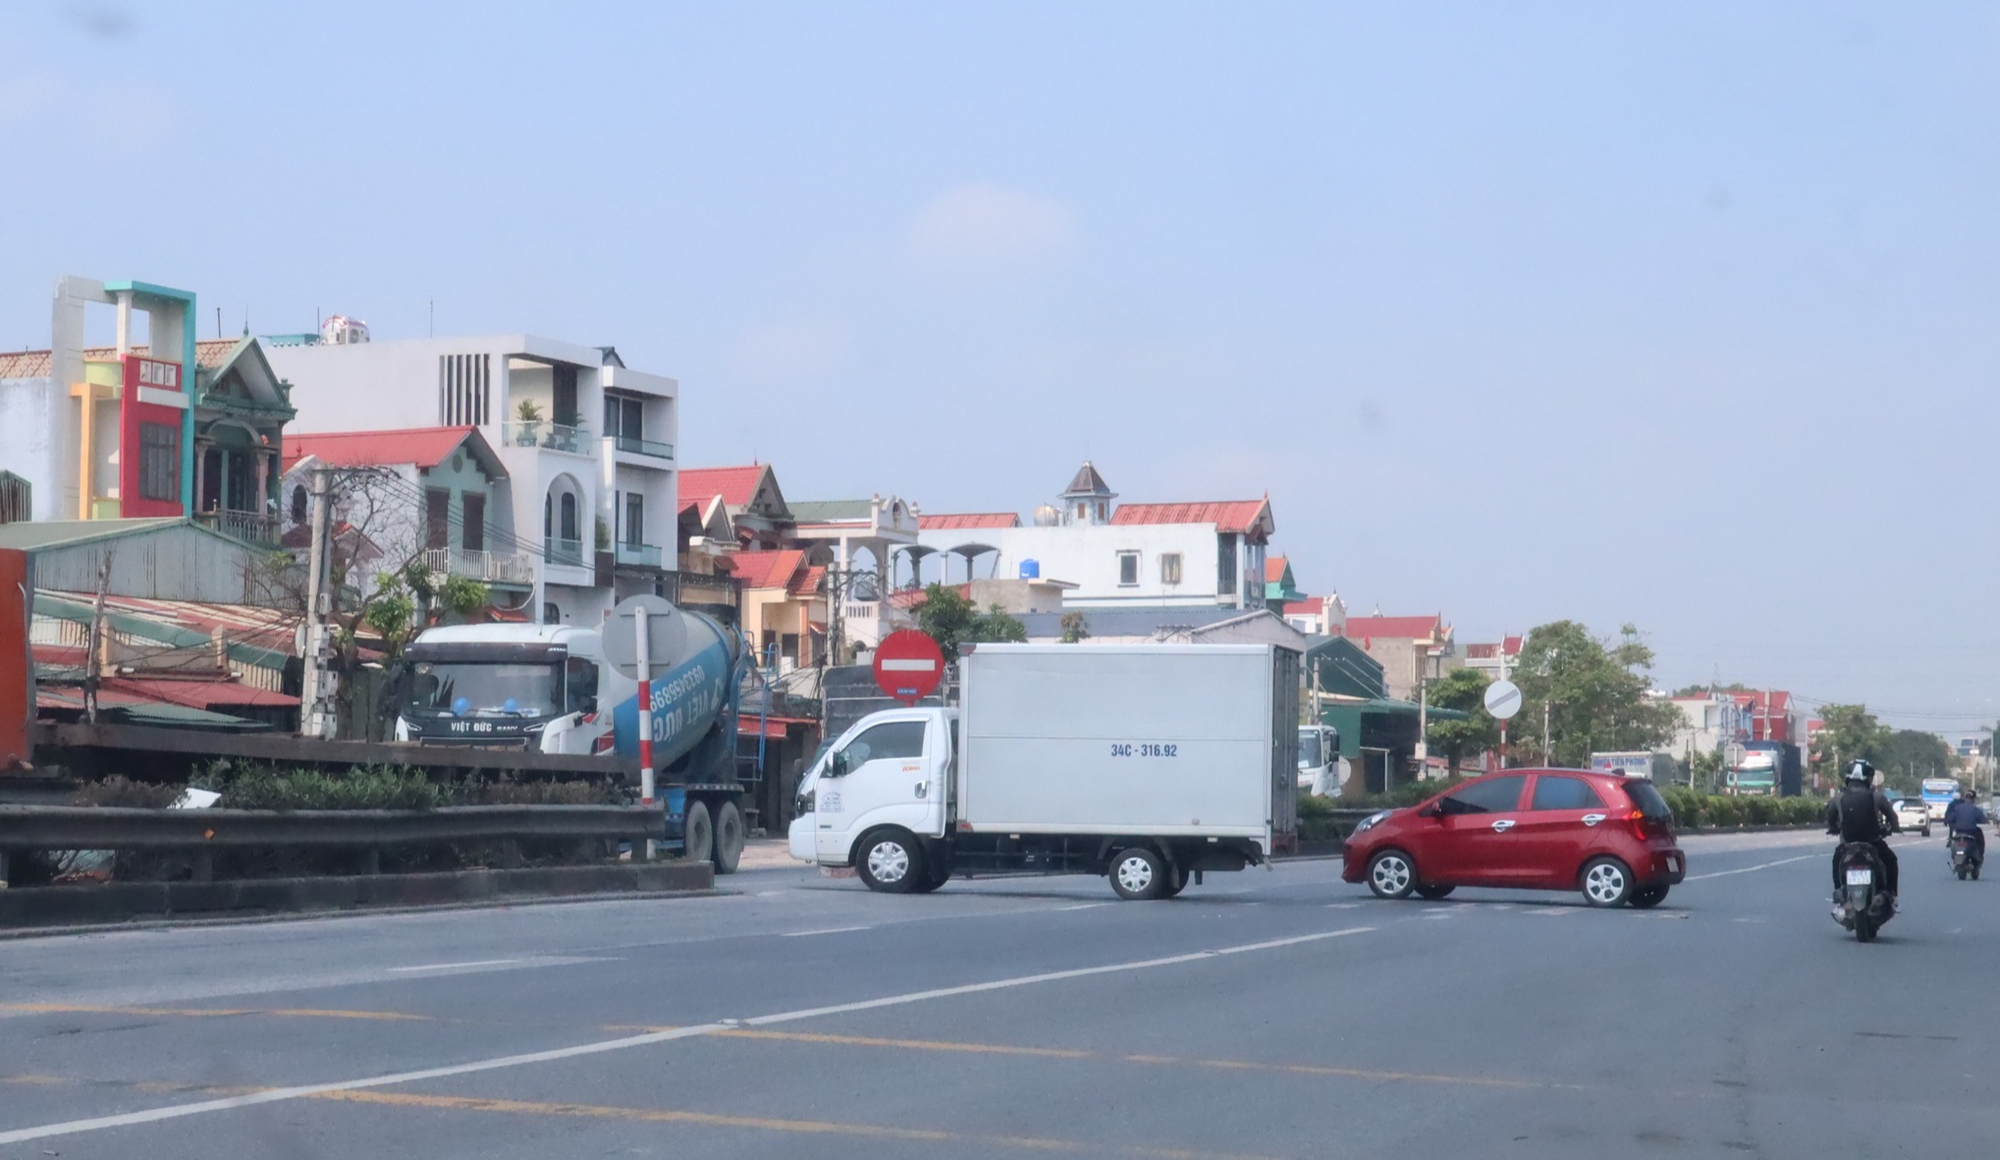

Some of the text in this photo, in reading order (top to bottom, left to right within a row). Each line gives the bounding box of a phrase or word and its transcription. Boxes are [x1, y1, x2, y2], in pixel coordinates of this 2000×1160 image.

[687, 689, 708, 725] VIỆT
[451, 721, 492, 733] VIỆT ĐỨC
[1111, 744, 1132, 757] 34C
[1141, 744, 1177, 757] 316.92
